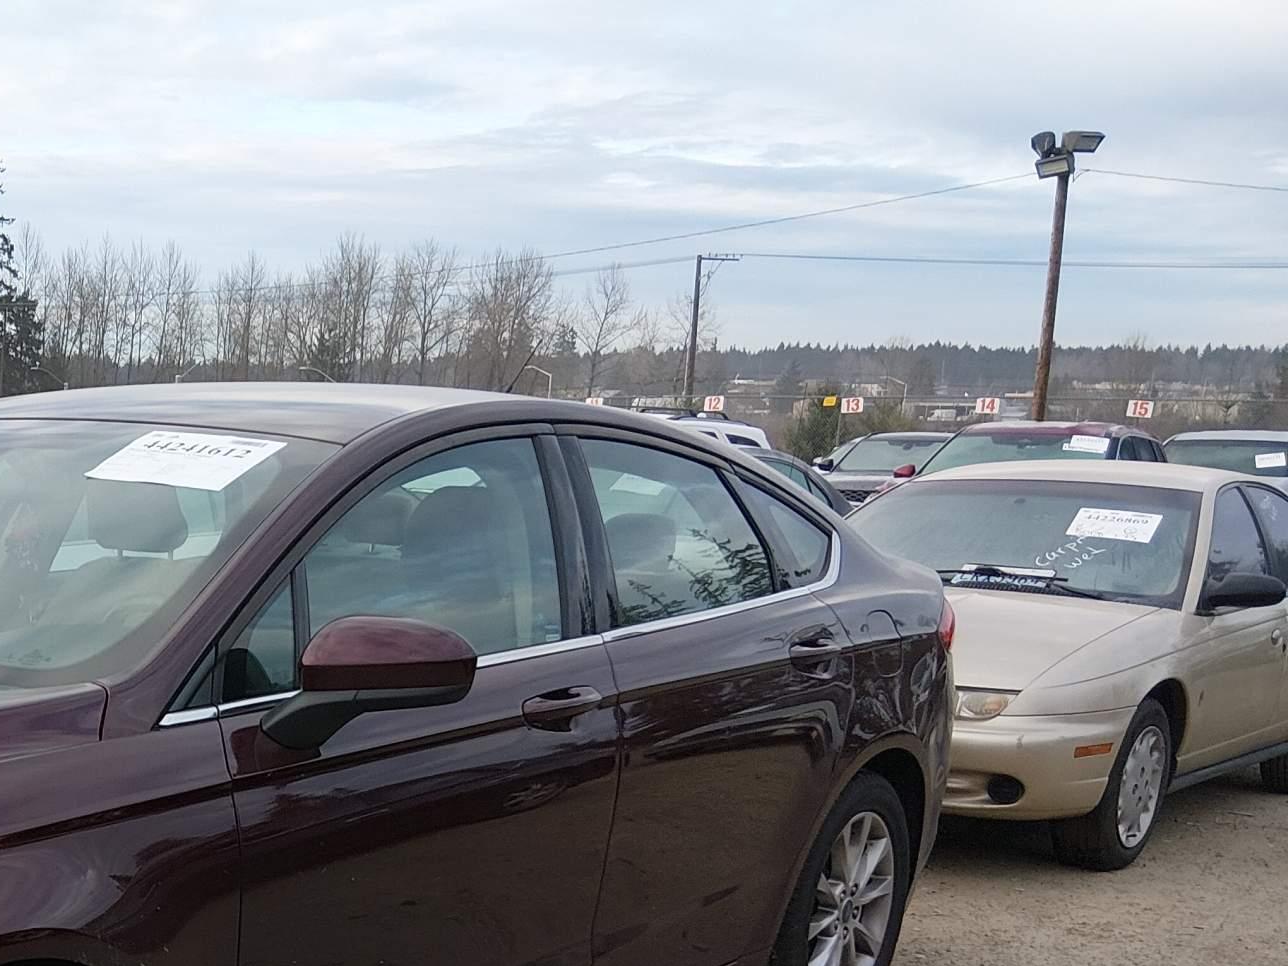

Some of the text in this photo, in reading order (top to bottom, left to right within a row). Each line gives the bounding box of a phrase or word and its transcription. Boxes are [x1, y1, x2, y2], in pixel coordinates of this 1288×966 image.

[707, 397, 721, 410] 12
[846, 398, 860, 411] 13
[980, 398, 995, 412] 14
[1132, 401, 1149, 416] 15
[143, 440, 252, 458] 44241612
